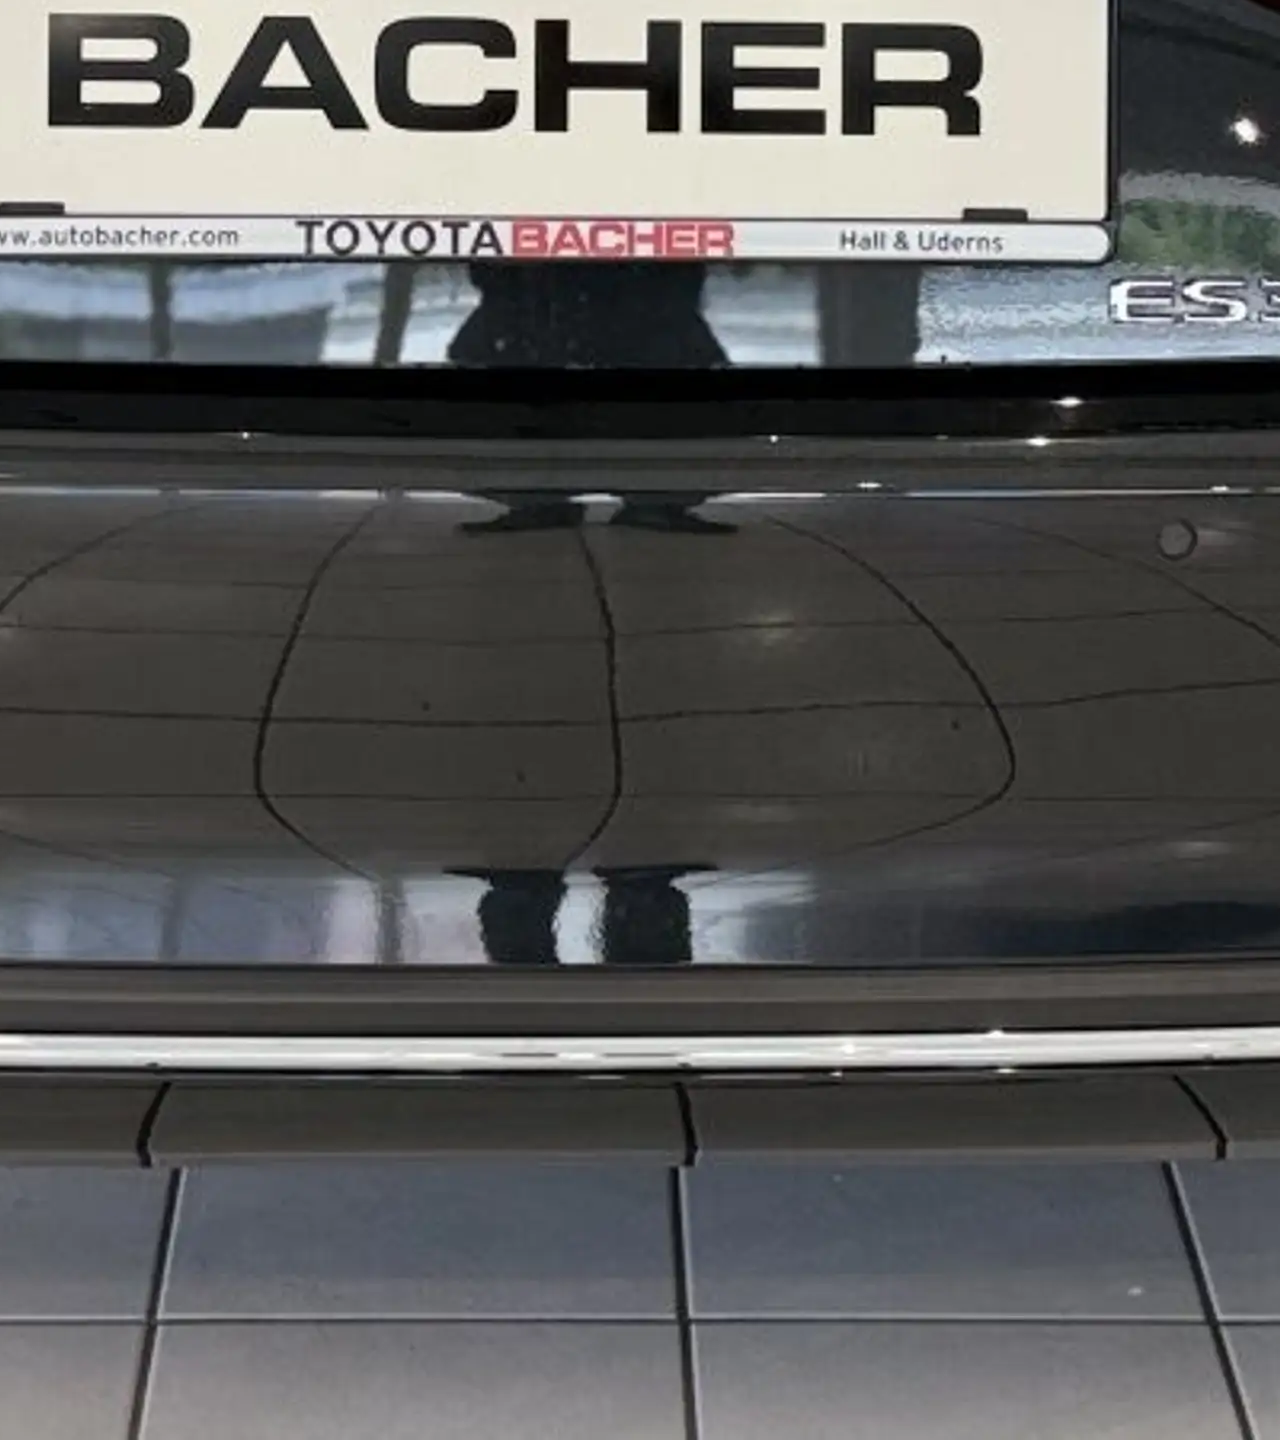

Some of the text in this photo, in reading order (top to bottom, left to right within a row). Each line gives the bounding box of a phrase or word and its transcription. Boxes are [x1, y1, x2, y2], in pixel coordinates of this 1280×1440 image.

[47, 12, 984, 137] BACHER
[295, 219, 735, 258] TOYOTA BACHER
[839, 229, 1005, 254] Hall & Uderns
